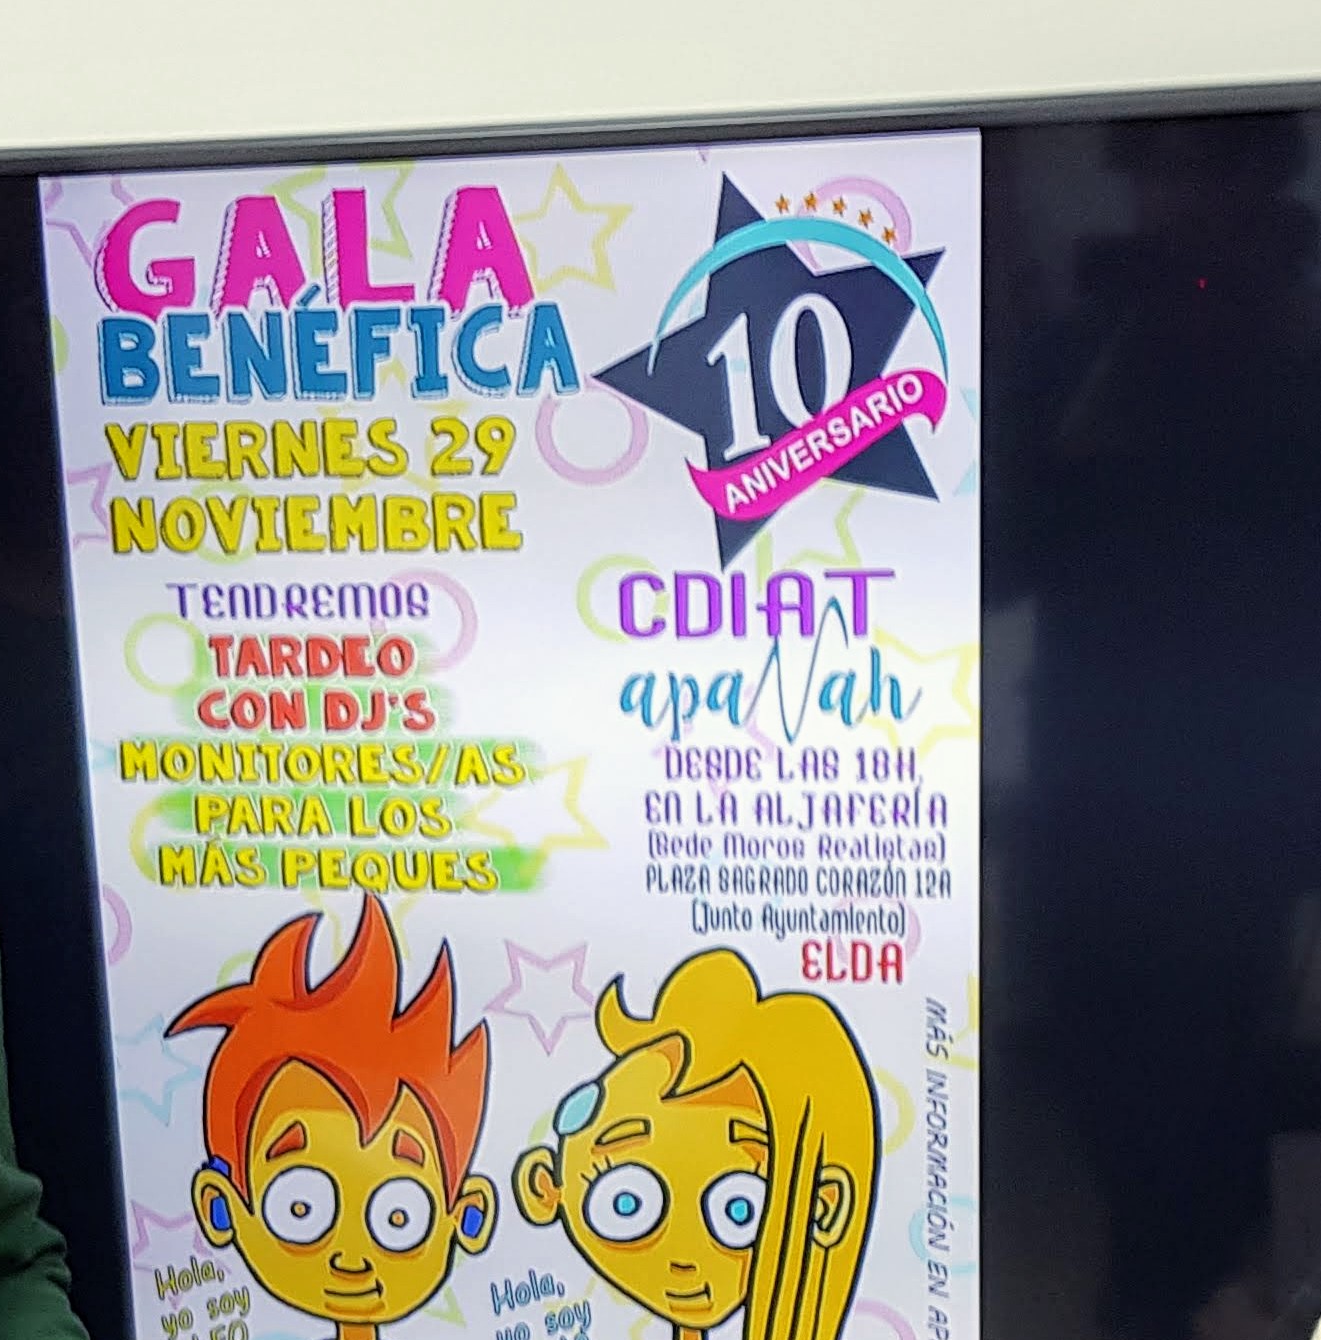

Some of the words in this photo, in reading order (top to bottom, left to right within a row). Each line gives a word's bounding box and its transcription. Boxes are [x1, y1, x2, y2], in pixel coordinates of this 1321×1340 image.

[93, 186, 534, 320] GALA
[99, 284, 579, 404] BENÉFICA
[707, 294, 853, 460] 10
[105, 417, 408, 480] VIERNES
[430, 417, 515, 475] 29
[723, 374, 924, 513] ANIVERSARIO
[111, 493, 522, 552] NOVIEMBRE
[166, 582, 429, 620] TENDREMOS
[619, 569, 895, 639] CDIAT
[208, 635, 414, 678] TARDEO
[198, 690, 307, 731] CON
[325, 690, 435, 731] DJ'S
[120, 742, 525, 784] MONITORES/AS
[665, 747, 761, 780] DESDE
[780, 748, 838, 781] LAS
[194, 795, 332, 835] PARA
[350, 796, 451, 838] LOS
[645, 793, 681, 823] EN
[696, 793, 737, 825] LA
[755, 786, 947, 829] ALJAFERÍA
[723, 834, 805, 859] Moros
[281, 848, 499, 893] PEQUES
[646, 864, 710, 896] PLAZA
[719, 866, 808, 896] SAGRADO
[816, 859, 906, 897] CORAZÓN
[915, 869, 951, 898] 12A
[801, 940, 903, 984] ELDA
[926, 1070, 954, 1252] INFORMACIÓN
[155, 1257, 224, 1299] Hola,
[490, 1270, 565, 1315] Hola,
[927, 1260, 949, 1299] EN
[206, 1286, 250, 1317] soy
[545, 1301, 591, 1335] soy
